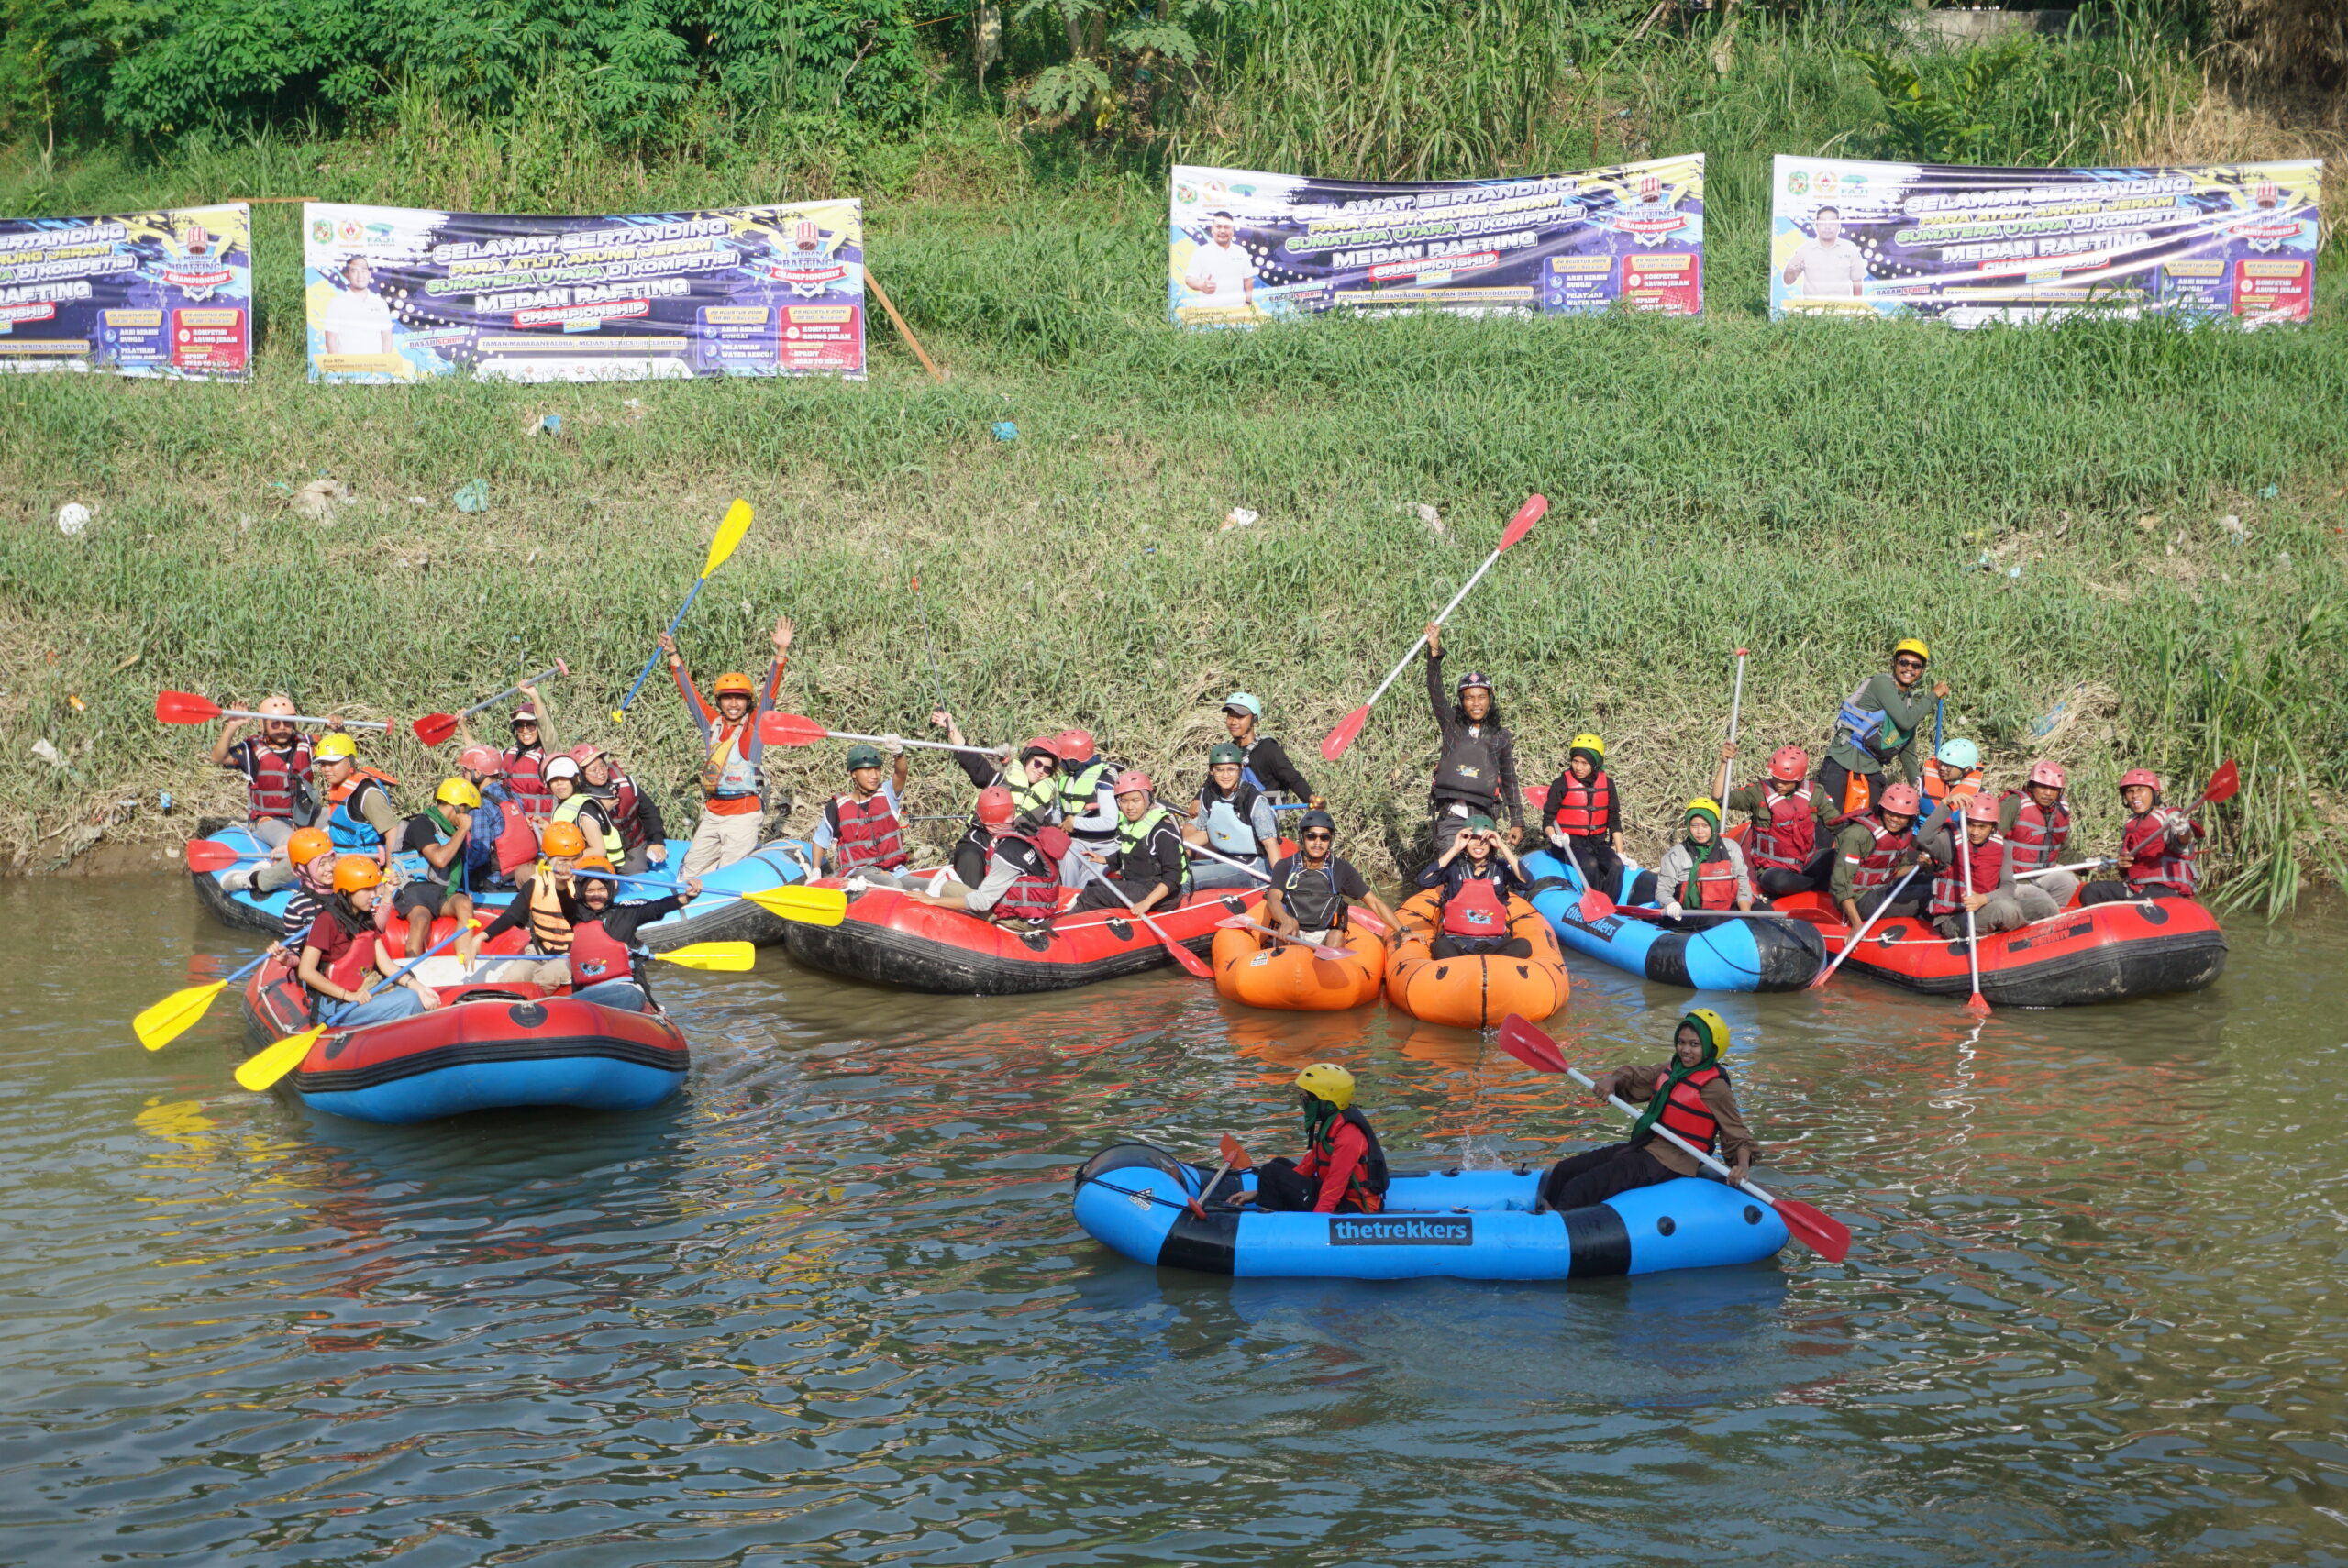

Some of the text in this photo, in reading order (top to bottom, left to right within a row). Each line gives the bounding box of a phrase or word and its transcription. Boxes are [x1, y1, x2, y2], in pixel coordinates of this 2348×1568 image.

[1294, 180, 1574, 220] SELAMAT BERTANDING
[1905, 178, 2192, 212] SELAMAT BERTANDING
[1311, 196, 1559, 233] PARA ATLIT ARUNG JERAM
[1627, 210, 1674, 218] RAFTING
[1922, 214, 1970, 226] PARA
[2034, 202, 2101, 217] ARUNG
[2106, 196, 2175, 211] JERAM
[0, 225, 126, 249] ERTANDING
[1288, 207, 1582, 249] SUMATERA UTARA DI KOMPETISI
[1620, 220, 1681, 231] CHAMPIONSHIP
[1897, 208, 2198, 243] SUMATERA UTARA DI KOMPETISI
[2235, 226, 2296, 237] CHAMPIONSHIP
[47, 245, 110, 259] JERAM
[434, 220, 727, 262] SELAMAT BERTANDING
[1333, 232, 1537, 269] MEDAN RAFTING
[1943, 240, 2034, 263] MEDAN
[2039, 232, 2149, 256] RAFTING
[18, 266, 35, 278] DI
[40, 257, 132, 276] KOMPETISI
[451, 239, 711, 275] PARA ATLIT ARUNG JERAM
[1373, 255, 1496, 278] CHAMPIONSHIP
[168, 273, 227, 284] CHAMPIONSHIP
[426, 252, 737, 293] SUMATERA UTARA DI KOMPETISI
[775, 270, 840, 281] CHAMPIONSHIP
[475, 279, 688, 313] MEDAN RAFTING
[518, 303, 646, 324] CHAMPIONSHIP
[410, 340, 436, 348] BASAH
[1335, 1220, 1467, 1239] thetrekkers
